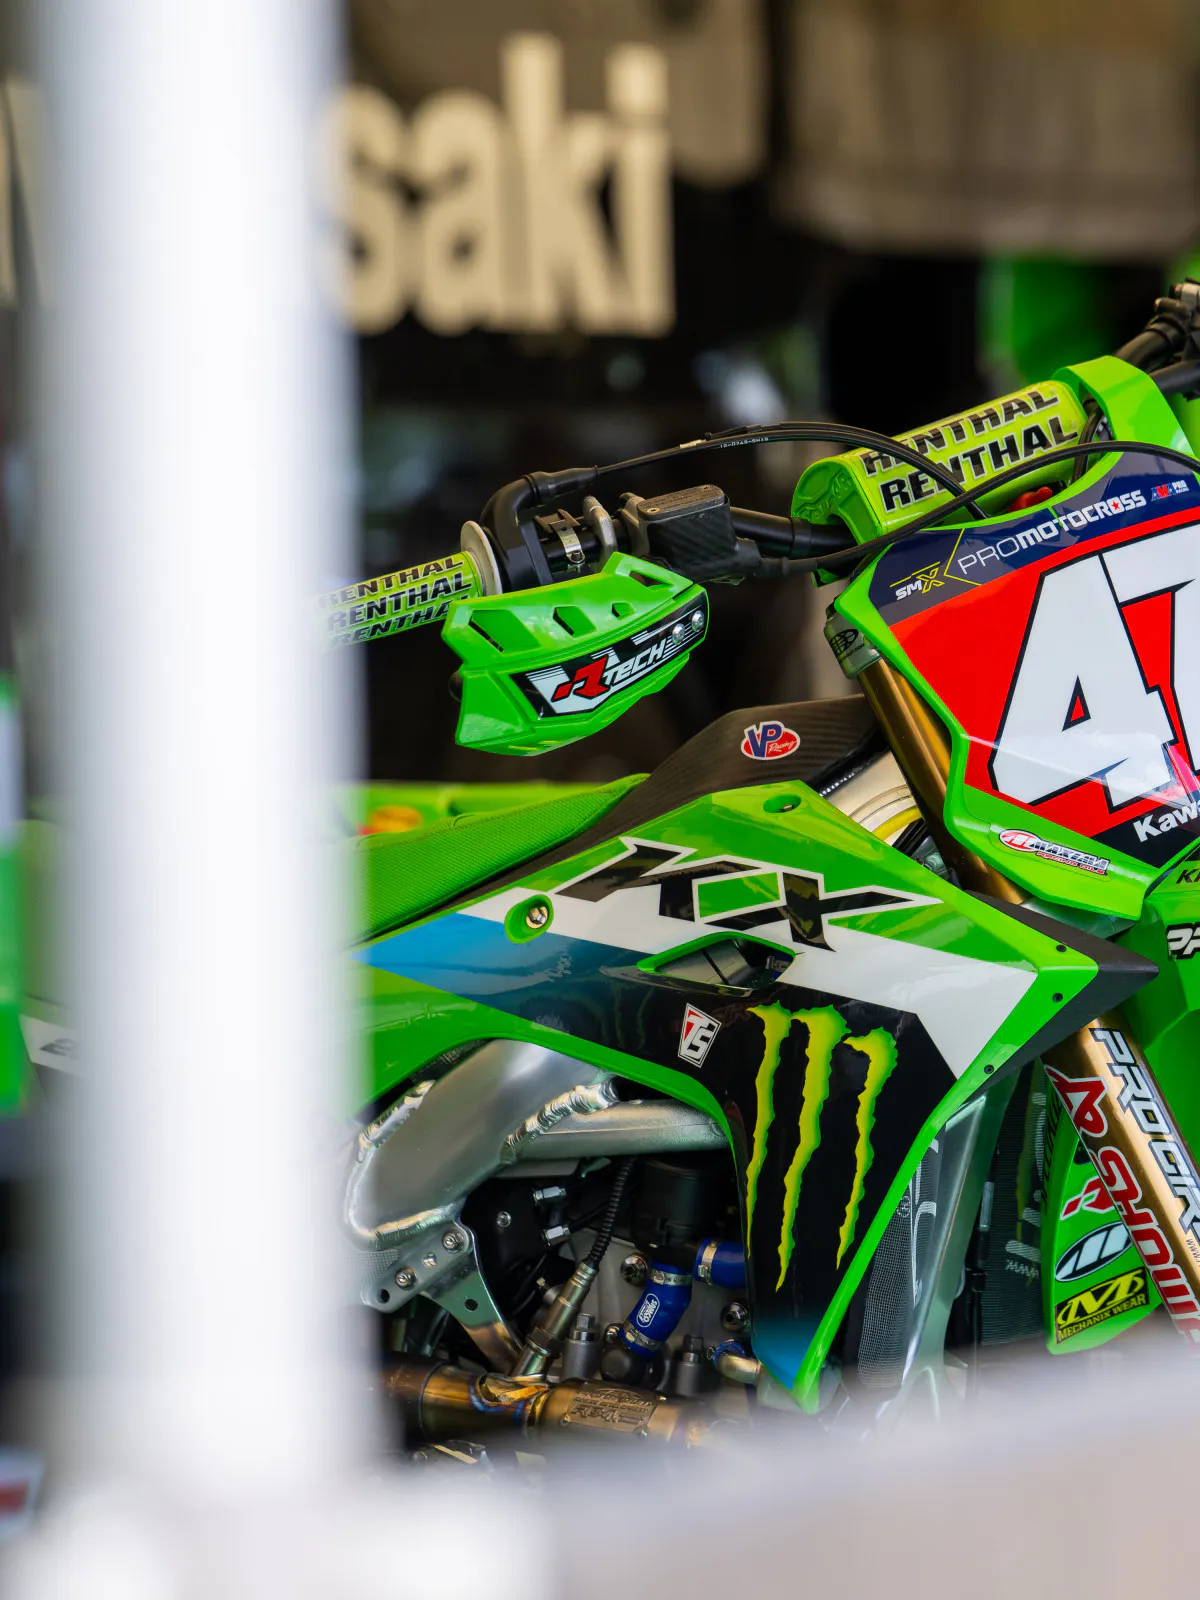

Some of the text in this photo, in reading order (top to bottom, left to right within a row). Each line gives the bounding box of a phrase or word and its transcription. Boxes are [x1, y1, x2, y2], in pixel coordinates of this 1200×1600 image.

[747, 724, 797, 758] VP Racing
[1090, 1028, 1171, 1135] PRO
[643, 1299, 657, 1323] SAMCO
[1058, 1293, 1146, 1341] MECHANIX WEAR
